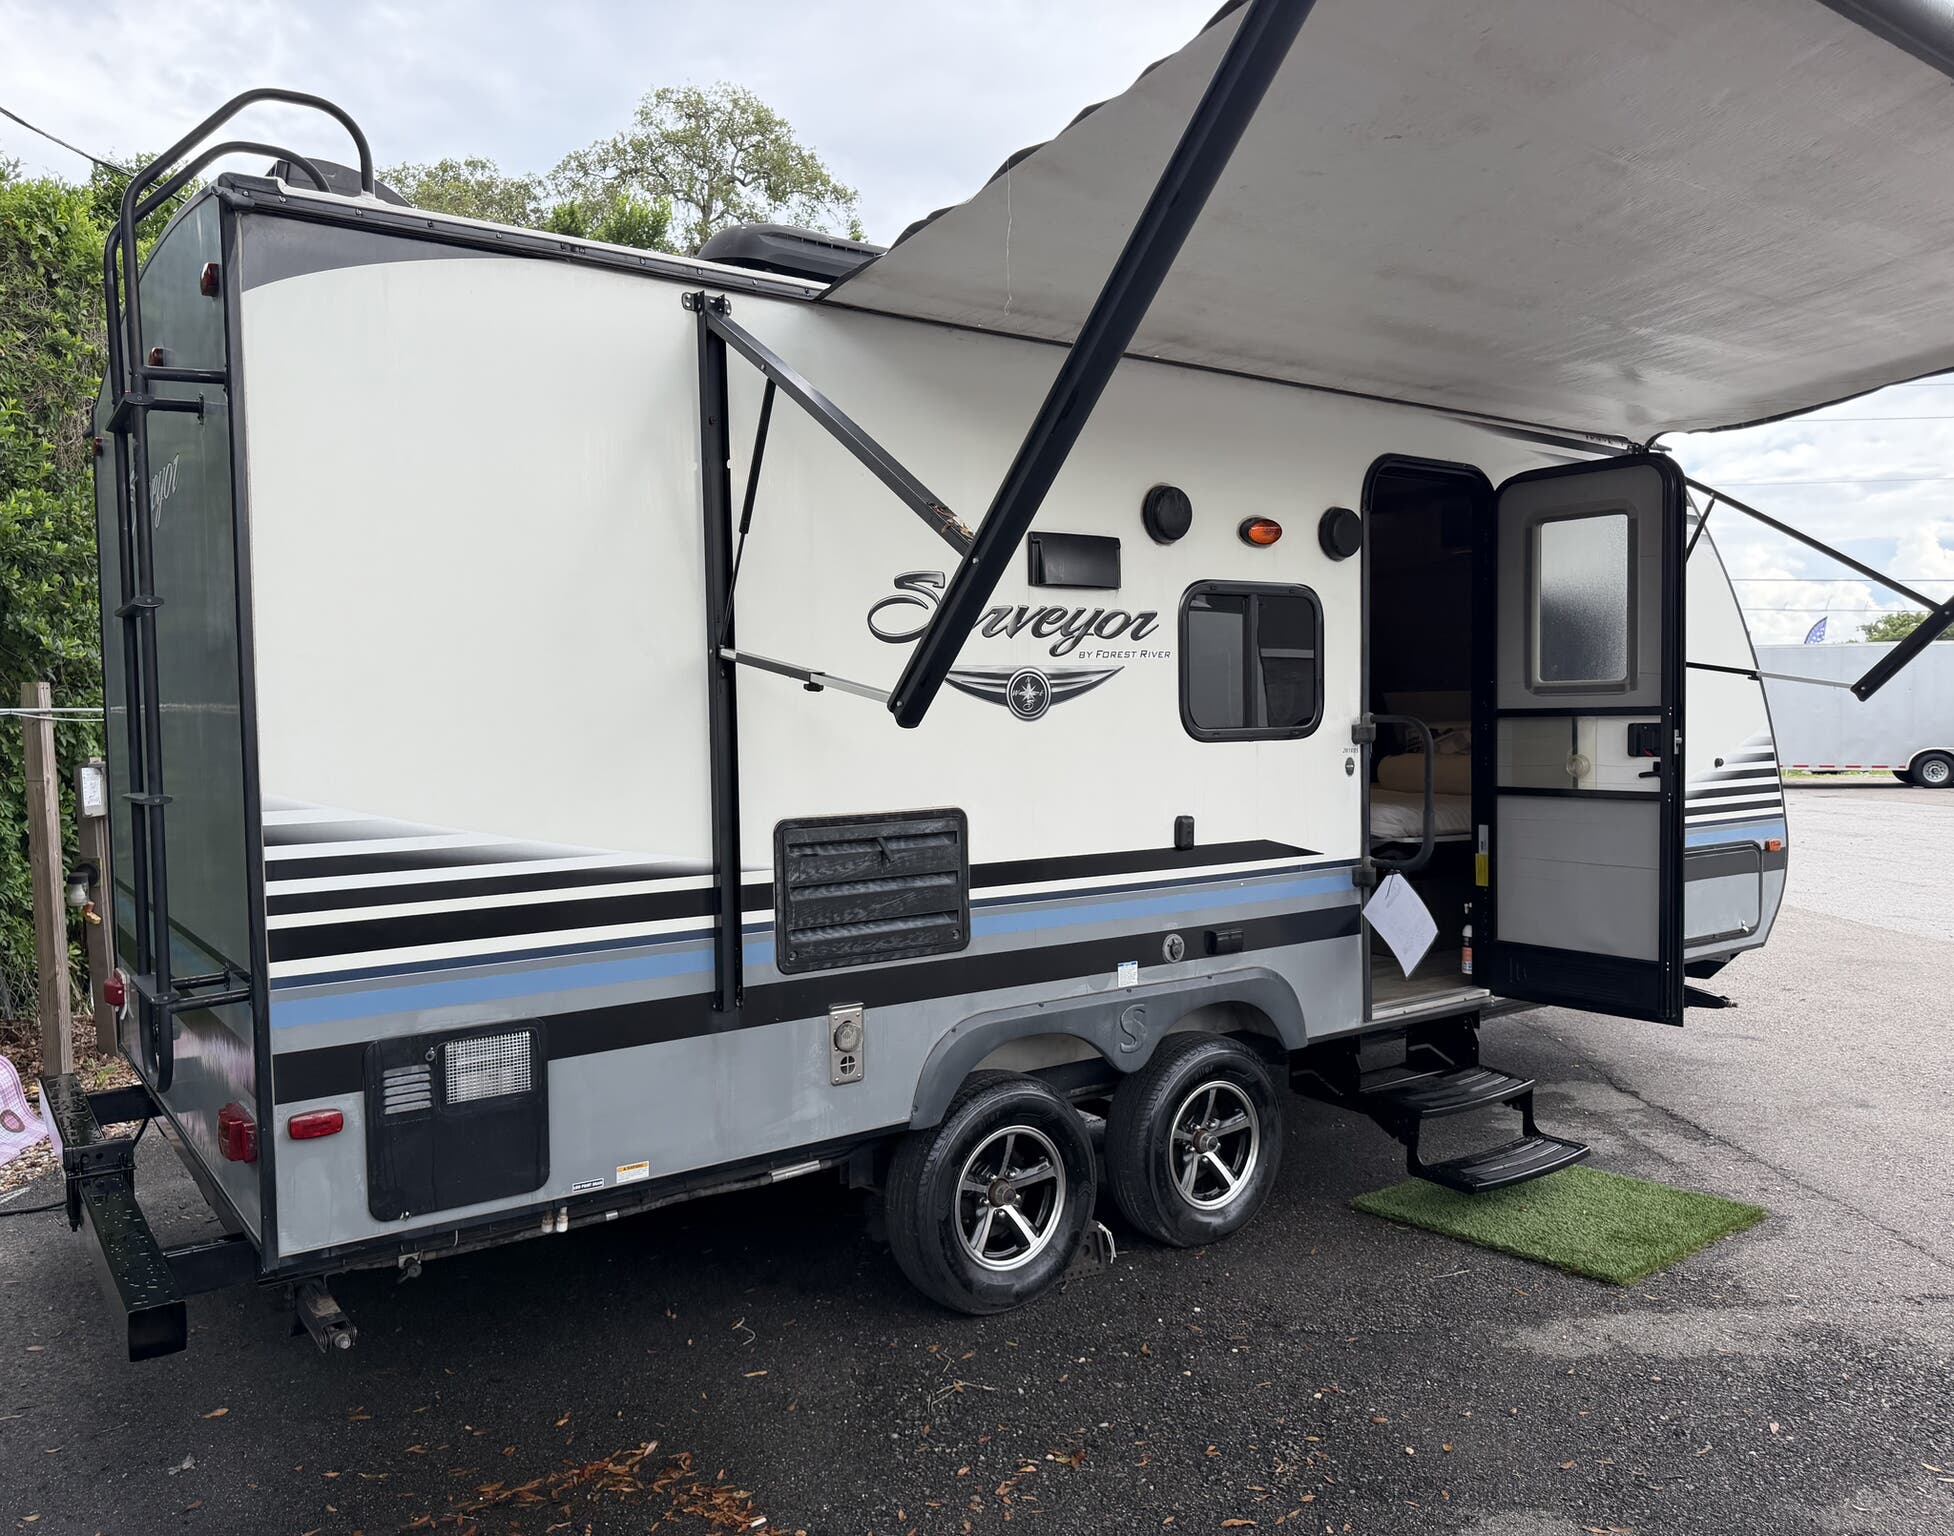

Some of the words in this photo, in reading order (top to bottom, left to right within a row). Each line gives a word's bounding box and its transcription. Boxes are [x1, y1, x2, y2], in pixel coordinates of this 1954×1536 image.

[867, 571, 1159, 658] Srveyor
[1078, 651, 1093, 659] BY
[1095, 650, 1137, 659] FOREST
[1139, 650, 1171, 659] RIVER
[1120, 1003, 1146, 1054] S
